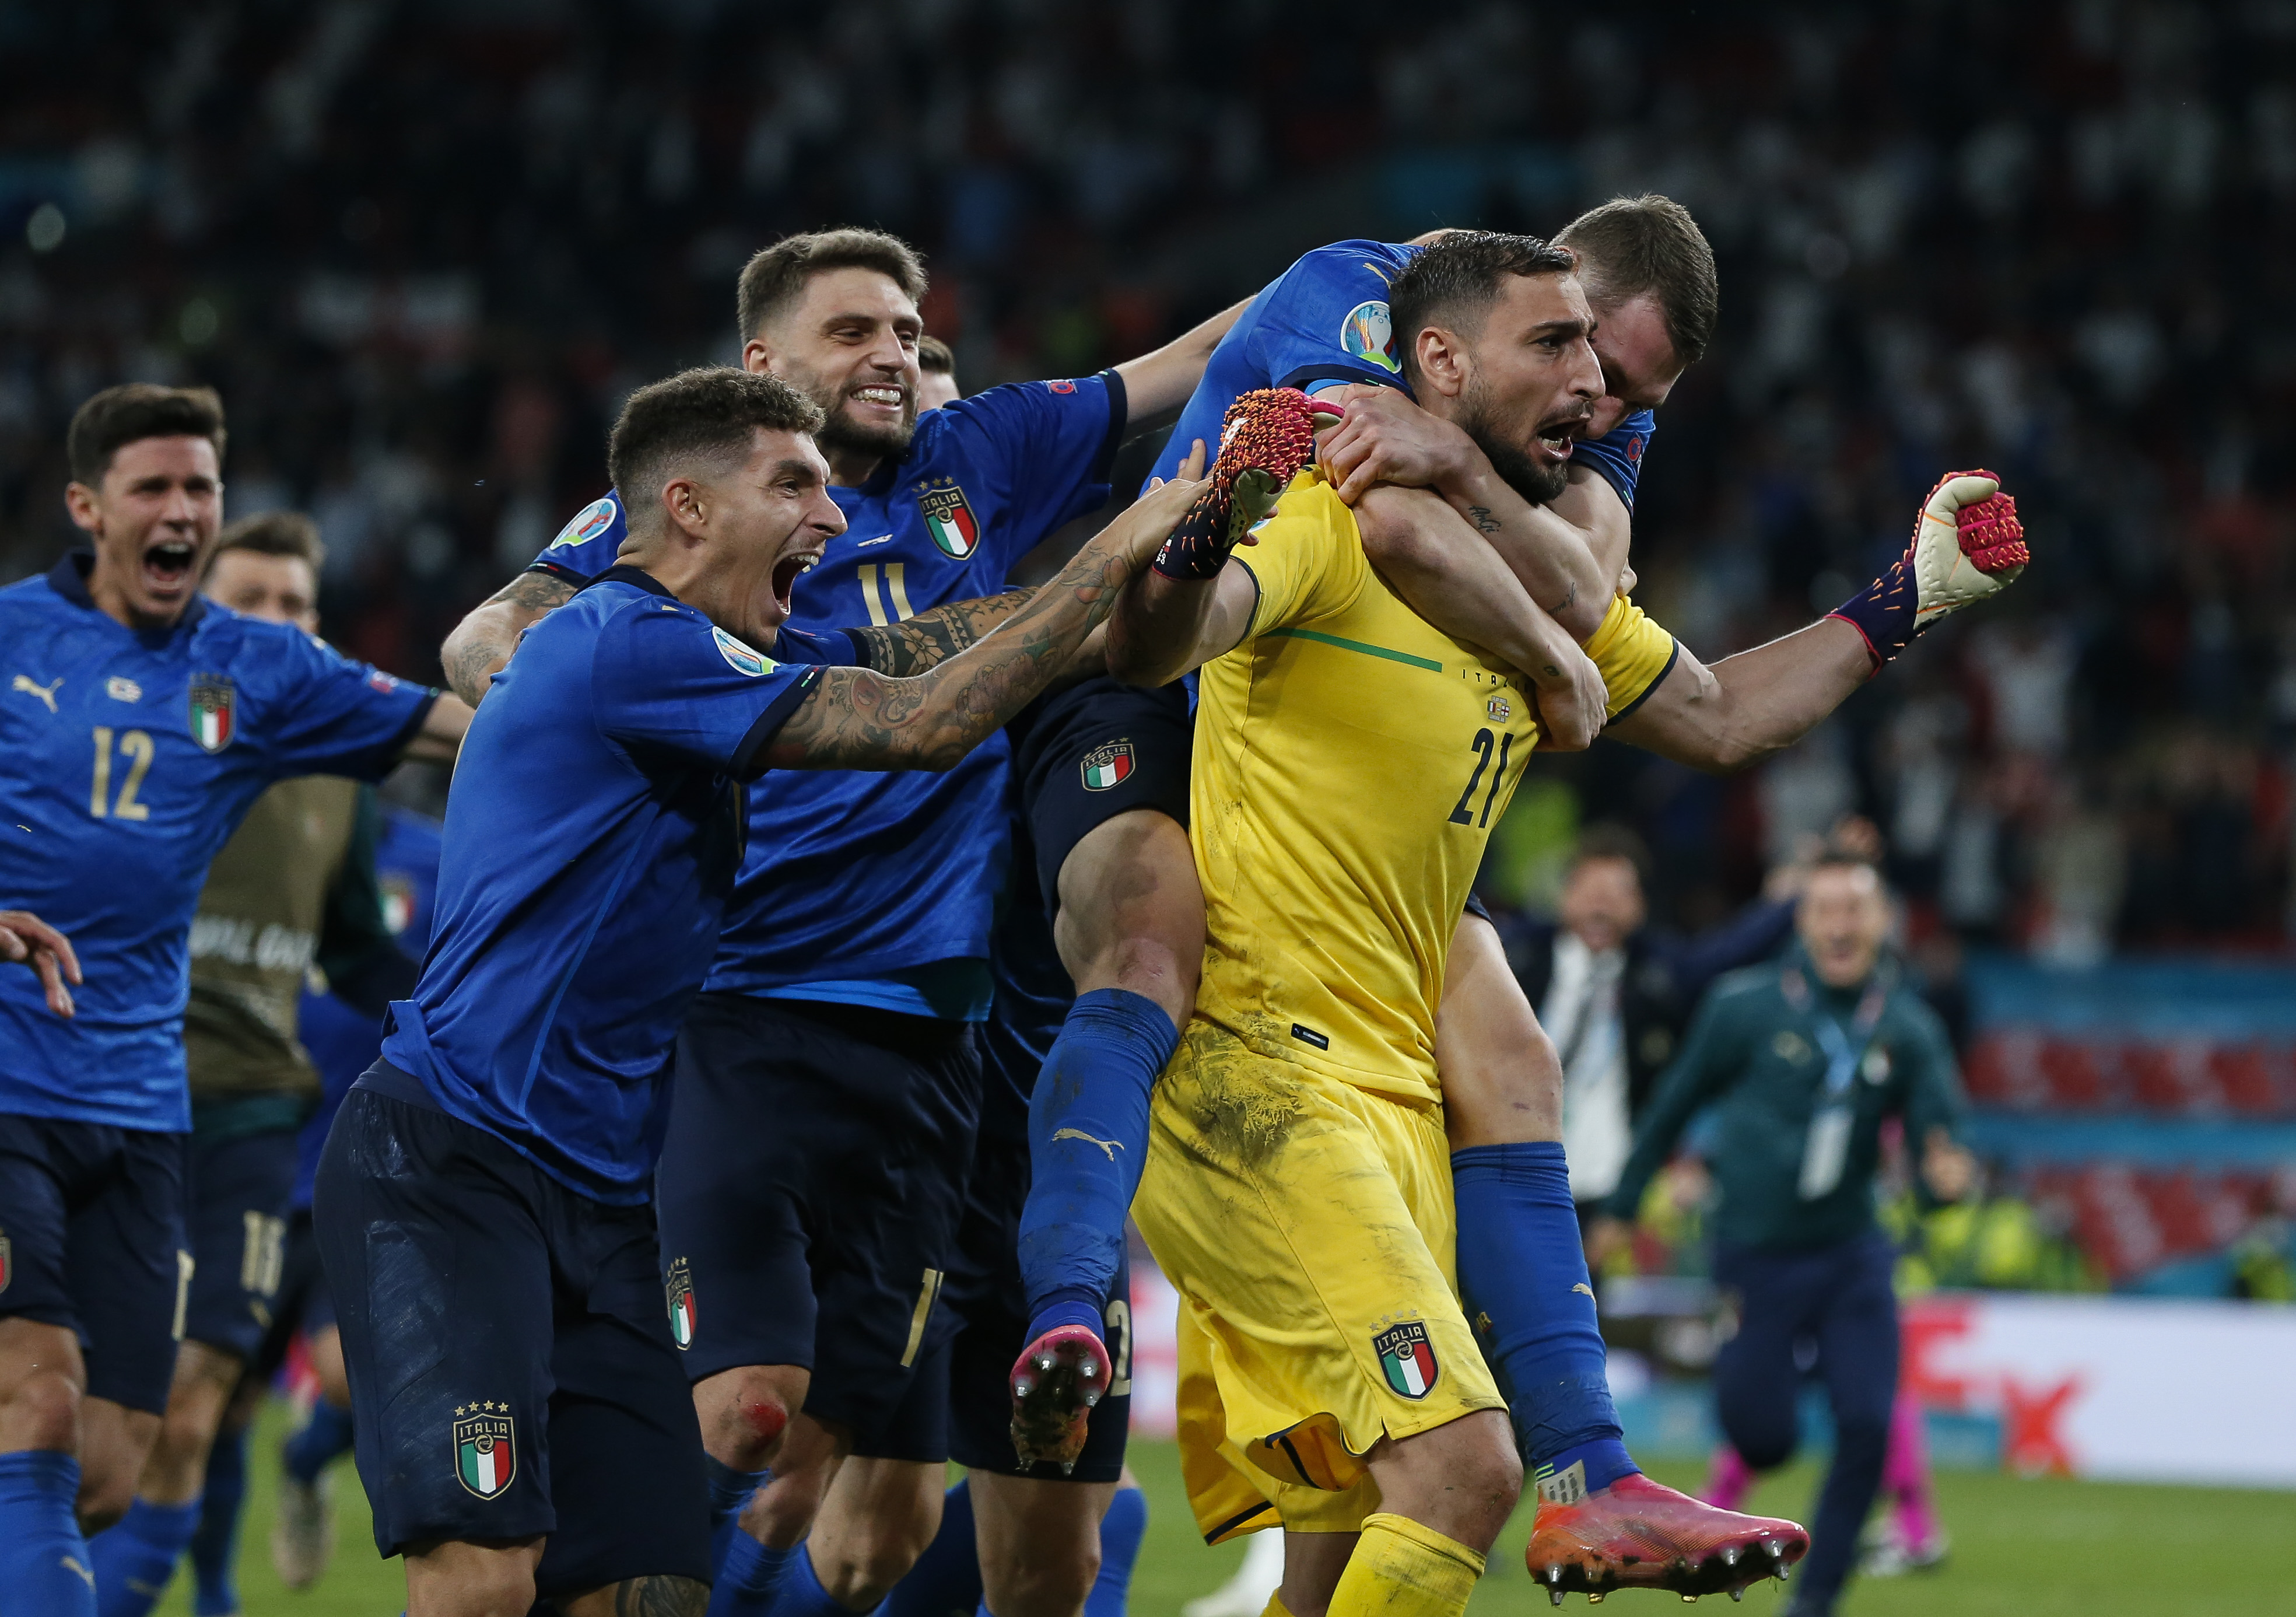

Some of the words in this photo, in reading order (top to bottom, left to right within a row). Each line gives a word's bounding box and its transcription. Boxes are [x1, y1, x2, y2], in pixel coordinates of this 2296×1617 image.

[921, 492, 960, 510] ITALIA
[857, 562, 914, 627] 11
[1086, 747, 1127, 767] ITALIA
[89, 725, 156, 822] 12
[1447, 727, 1515, 829] 21
[1377, 1326, 1423, 1350] ITALIA
[460, 1422, 508, 1438] ITALIA
